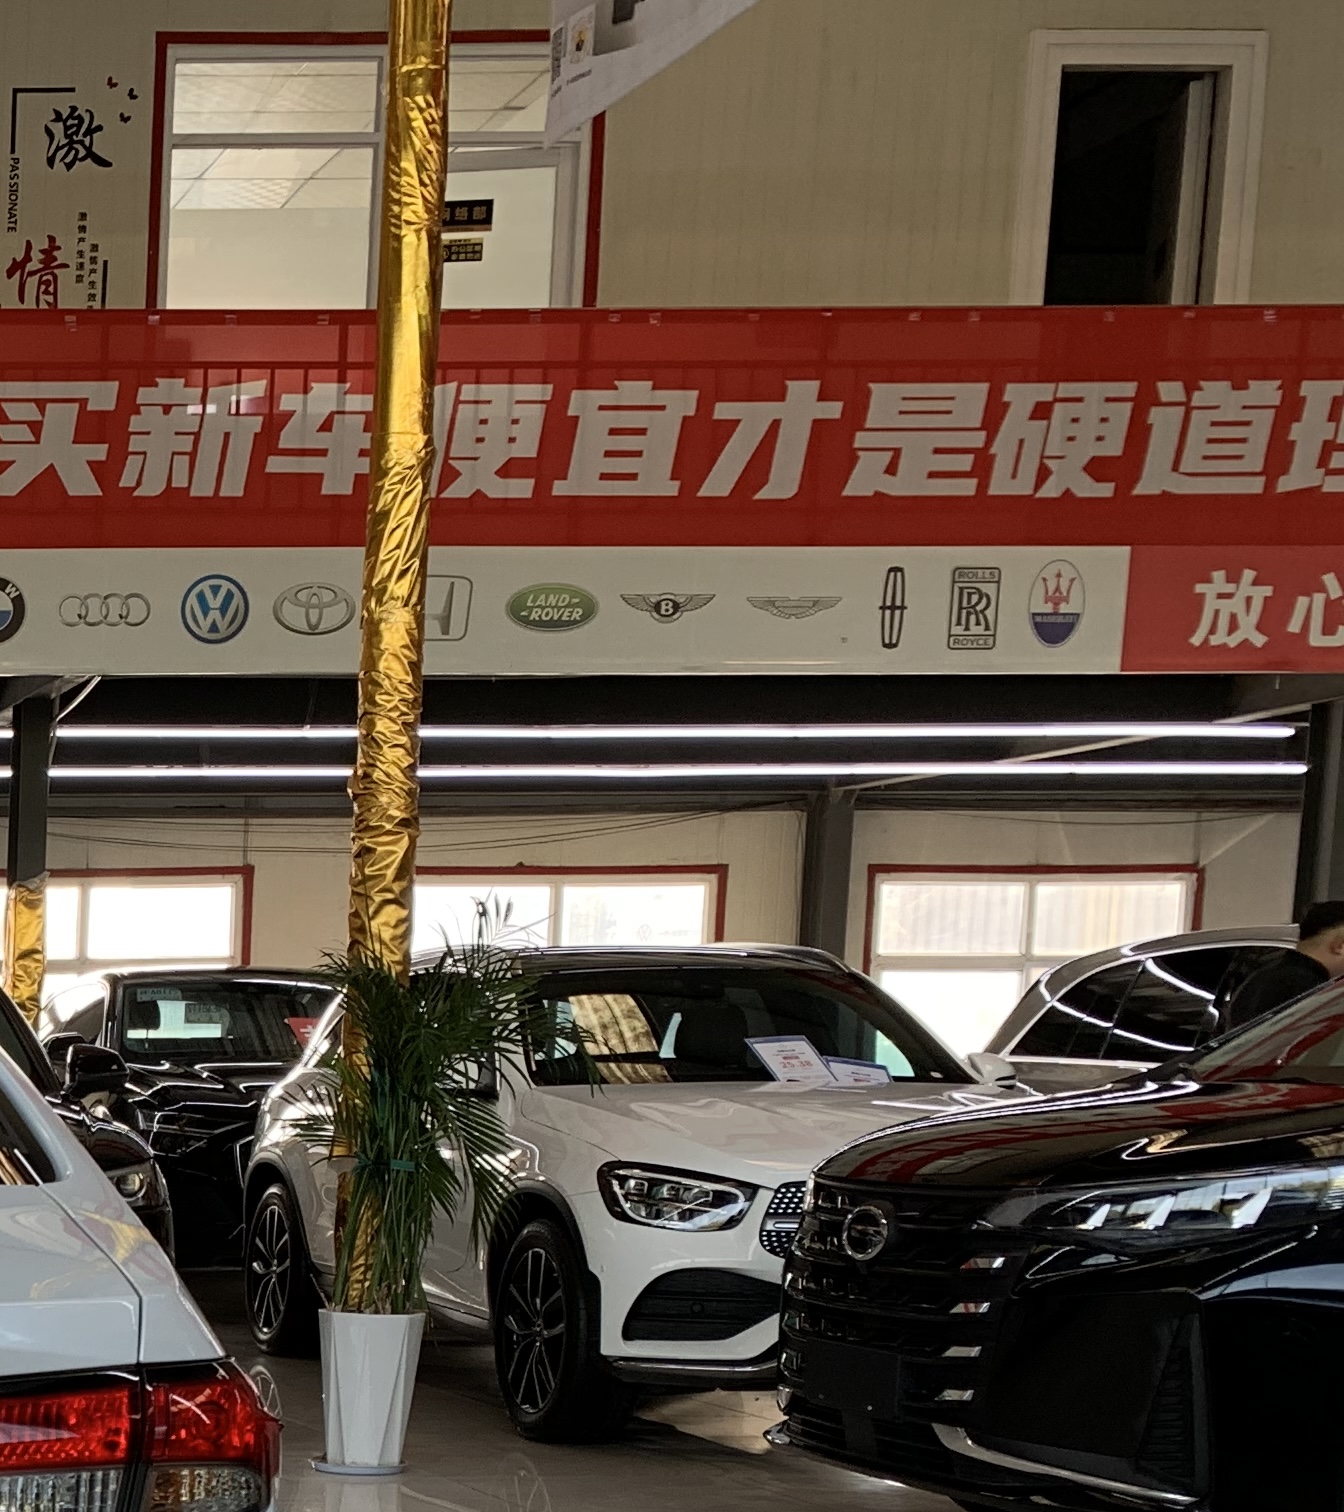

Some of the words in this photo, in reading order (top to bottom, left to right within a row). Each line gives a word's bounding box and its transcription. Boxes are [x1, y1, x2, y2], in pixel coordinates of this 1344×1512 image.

[44, 105, 113, 172] 激
[6, 156, 20, 233] PASSIONATE
[6, 234, 70, 309] 情
[957, 570, 997, 580] ROLLS
[1188, 568, 1344, 649] 放心
[952, 637, 992, 647] ROYCE
